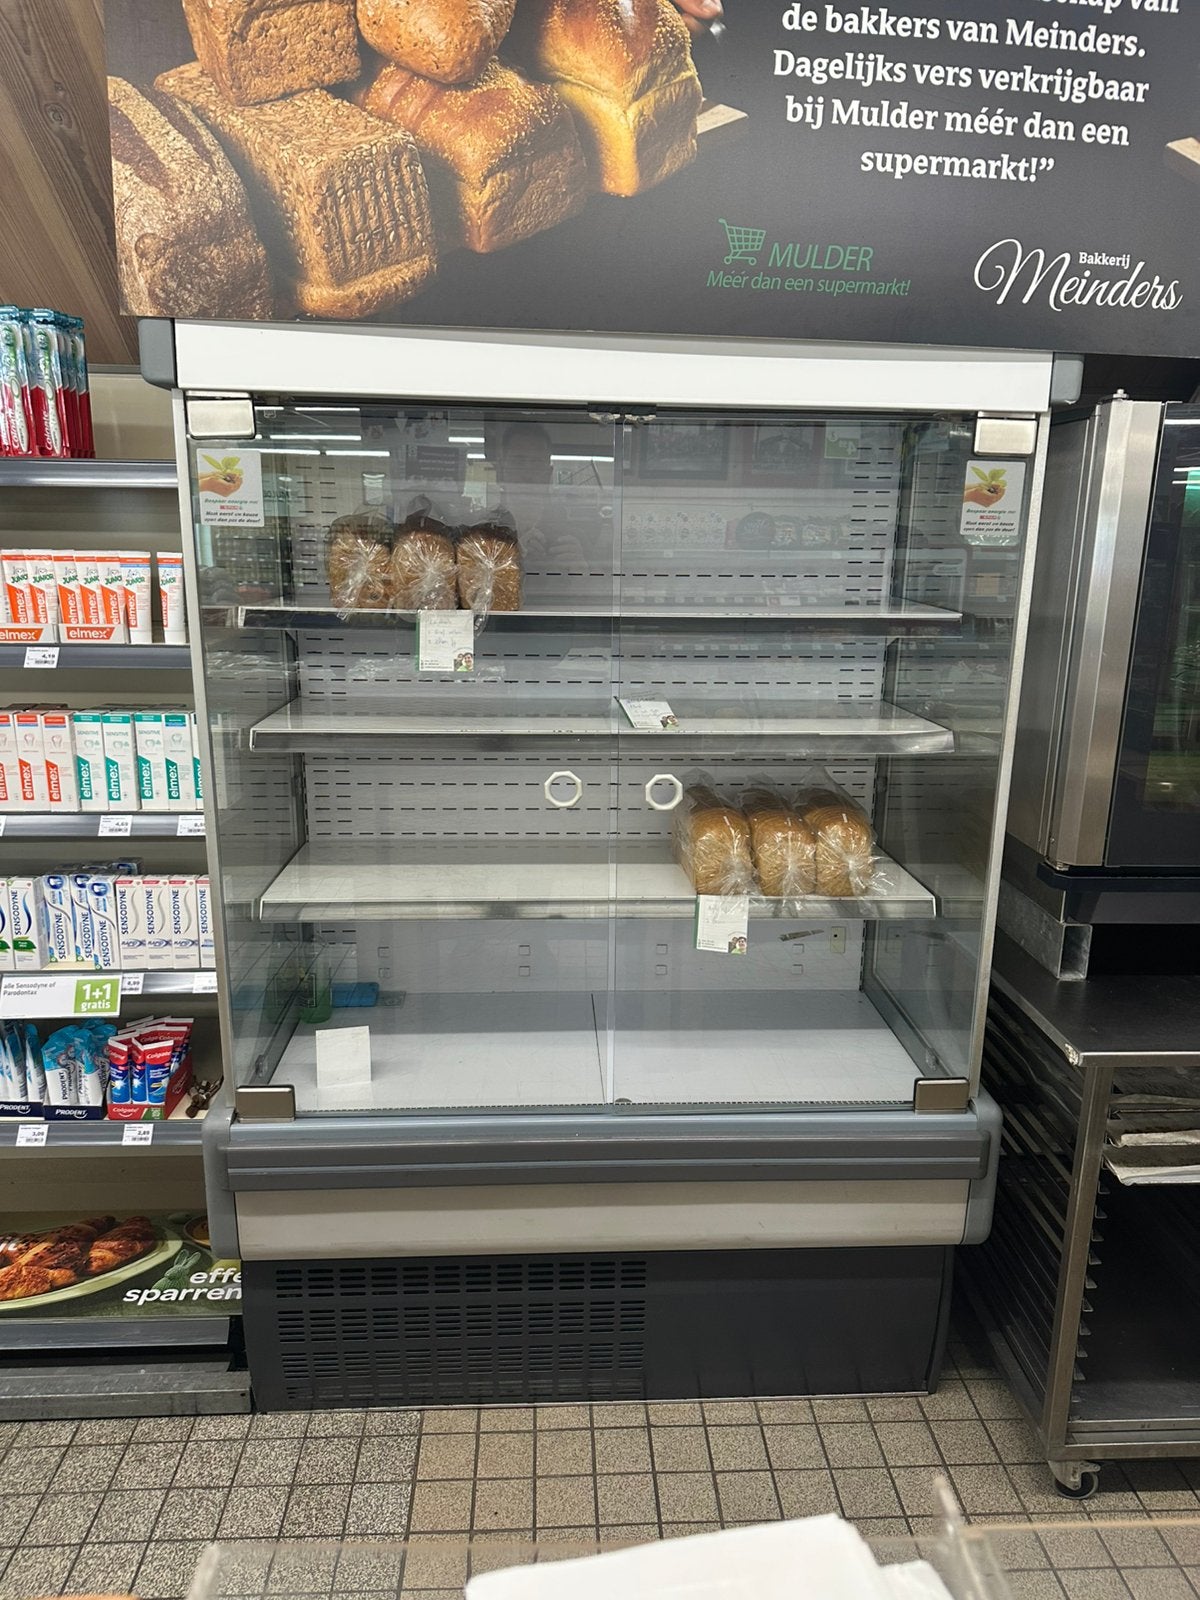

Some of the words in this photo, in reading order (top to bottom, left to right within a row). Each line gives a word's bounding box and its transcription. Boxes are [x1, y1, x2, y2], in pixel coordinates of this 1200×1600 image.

[781, 3, 818, 32] de
[825, 4, 940, 40] bakkers
[946, 20, 999, 44] van
[1005, 18, 1147, 58] Meinders.
[773, 49, 907, 88] Dagelijks
[913, 64, 972, 88] vers
[978, 65, 1150, 104] verkrijgbaar
[785, 95, 825, 129] bij
[831, 98, 939, 131] Mulder
[944, 106, 1018, 136] méér
[1023, 109, 1076, 142] dan
[1081, 122, 1130, 146] een
[768, 241, 875, 272] MULDER
[1078, 250, 1131, 270] Bakkerij
[751, 271, 781, 290] dan
[784, 277, 814, 292] een
[817, 277, 912, 297] supermarkt!
[973, 238, 1184, 312] Meinders
[16, 590, 27, 623] elmex
[37, 591, 47, 623] elmex
[67, 592, 78, 624] elmex
[88, 592, 99, 624] elmex
[109, 592, 120, 624] elmex
[128, 595, 136, 626] elmex
[0, 629, 36, 640] elmex
[69, 630, 107, 639] elmex
[23, 766, 33, 799] elmex
[49, 767, 60, 800] elmex
[81, 763, 91, 798] elmex
[109, 764, 120, 799] elmex
[142, 763, 152, 797] elmex
[168, 765, 179, 797] elmex
[11, 890, 22, 935] SENSODYNE
[119, 889, 129, 935] SENSODYNE
[146, 889, 155, 935] SENSODYNE
[172, 889, 181, 935] SENSODYNE
[199, 889, 208, 934] SENSODYNE
[55, 912, 66, 959] SENSODYNE
[82, 912, 92, 958] SENSODYNE
[99, 920, 111, 967] SENSODYNE
[81, 1000, 111, 1012] gratis
[82, 983, 112, 1000] 1+1
[146, 1051, 171, 1060] Colgate
[0, 1104, 30, 1112] PRODENT
[112, 1106, 140, 1114] Colgate
